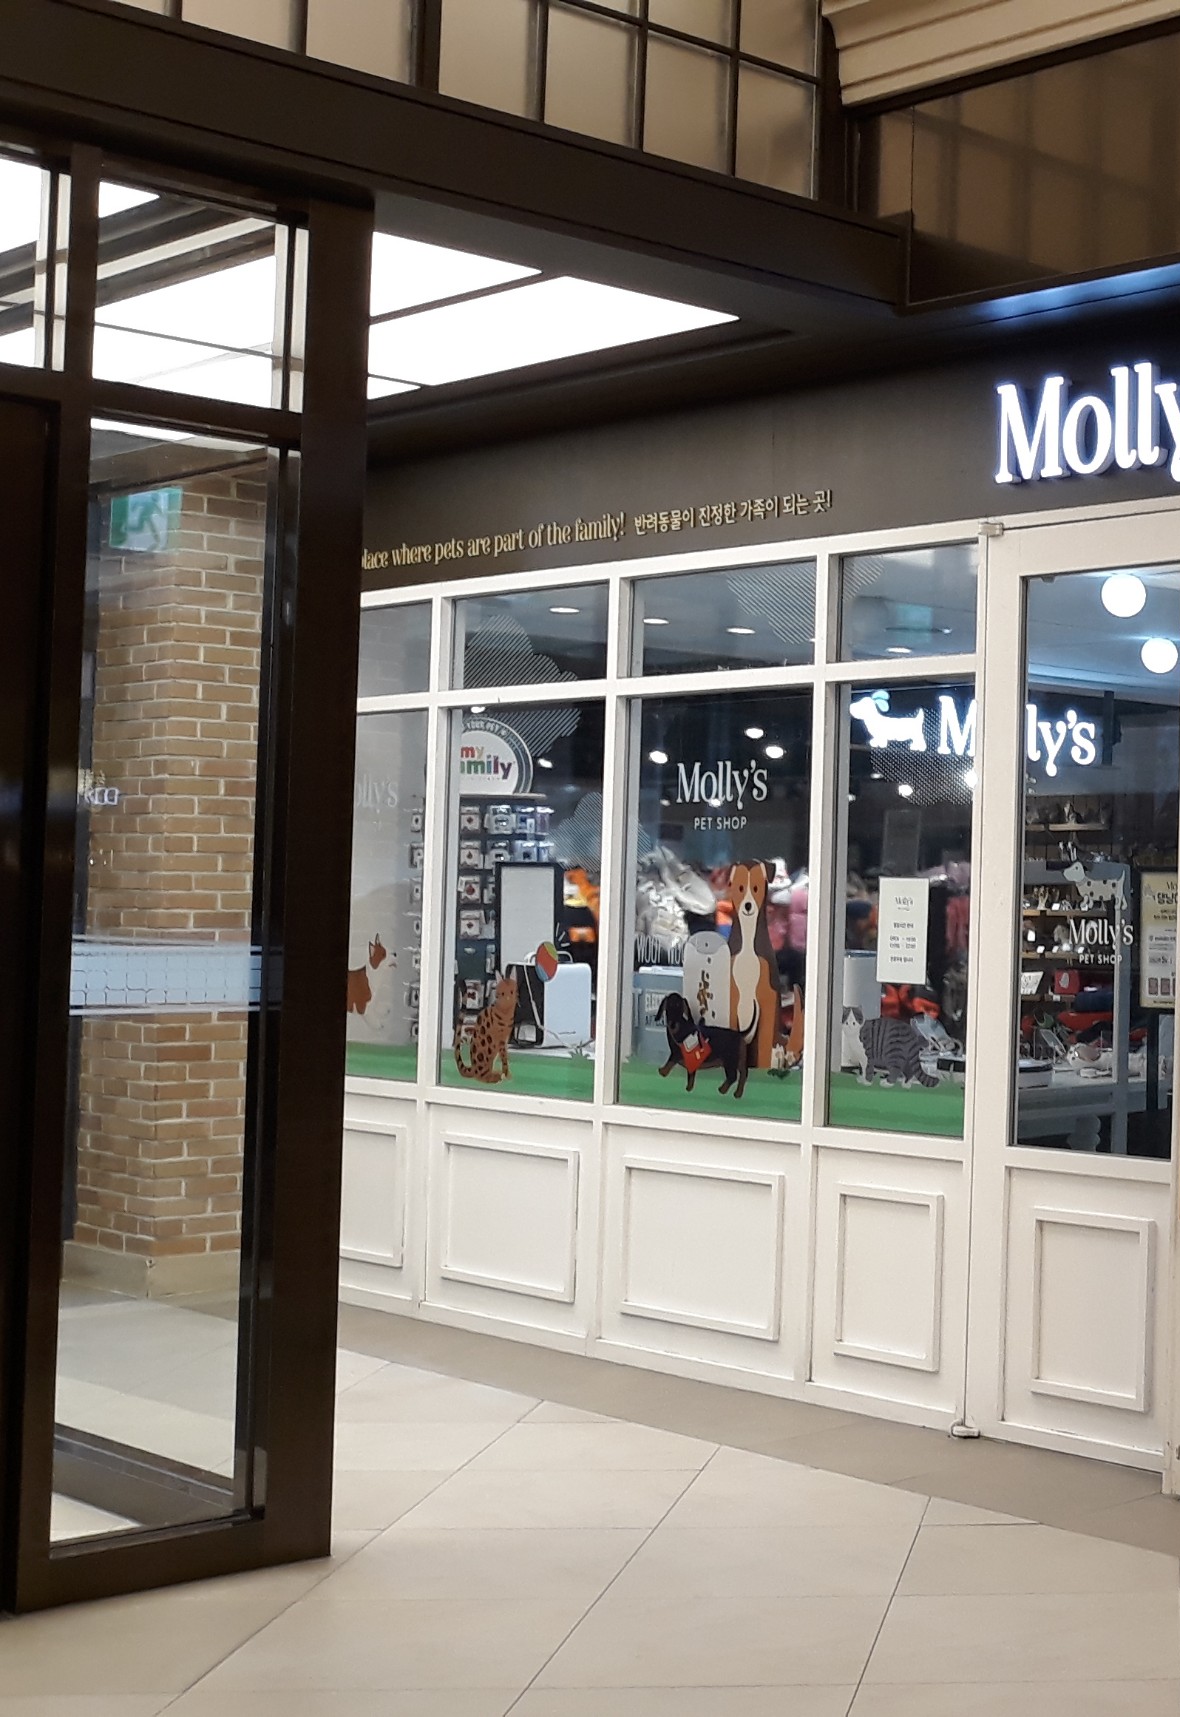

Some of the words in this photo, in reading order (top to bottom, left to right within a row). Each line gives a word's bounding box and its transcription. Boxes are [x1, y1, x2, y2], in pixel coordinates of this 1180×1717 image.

[634, 506, 696, 536] 반려동물이
[698, 501, 737, 527] 진정한
[740, 495, 780, 522] 가족이
[782, 492, 809, 516] 되는
[812, 488, 833, 513] 곳!
[361, 548, 389, 570] lace
[391, 540, 432, 566] where
[434, 537, 464, 565] pets
[467, 536, 492, 557] are
[494, 529, 525, 558] part
[528, 522, 546, 549] of
[546, 520, 572, 545] the
[574, 511, 627, 542] family!
[460, 745, 486, 761] my
[676, 758, 769, 810] Molly's
[694, 816, 715, 831] PET
[716, 815, 748, 830] SHOP
[1068, 917, 1135, 950] Molly's
[1079, 954, 1095, 965] PET
[1097, 954, 1123, 965] SHOP
